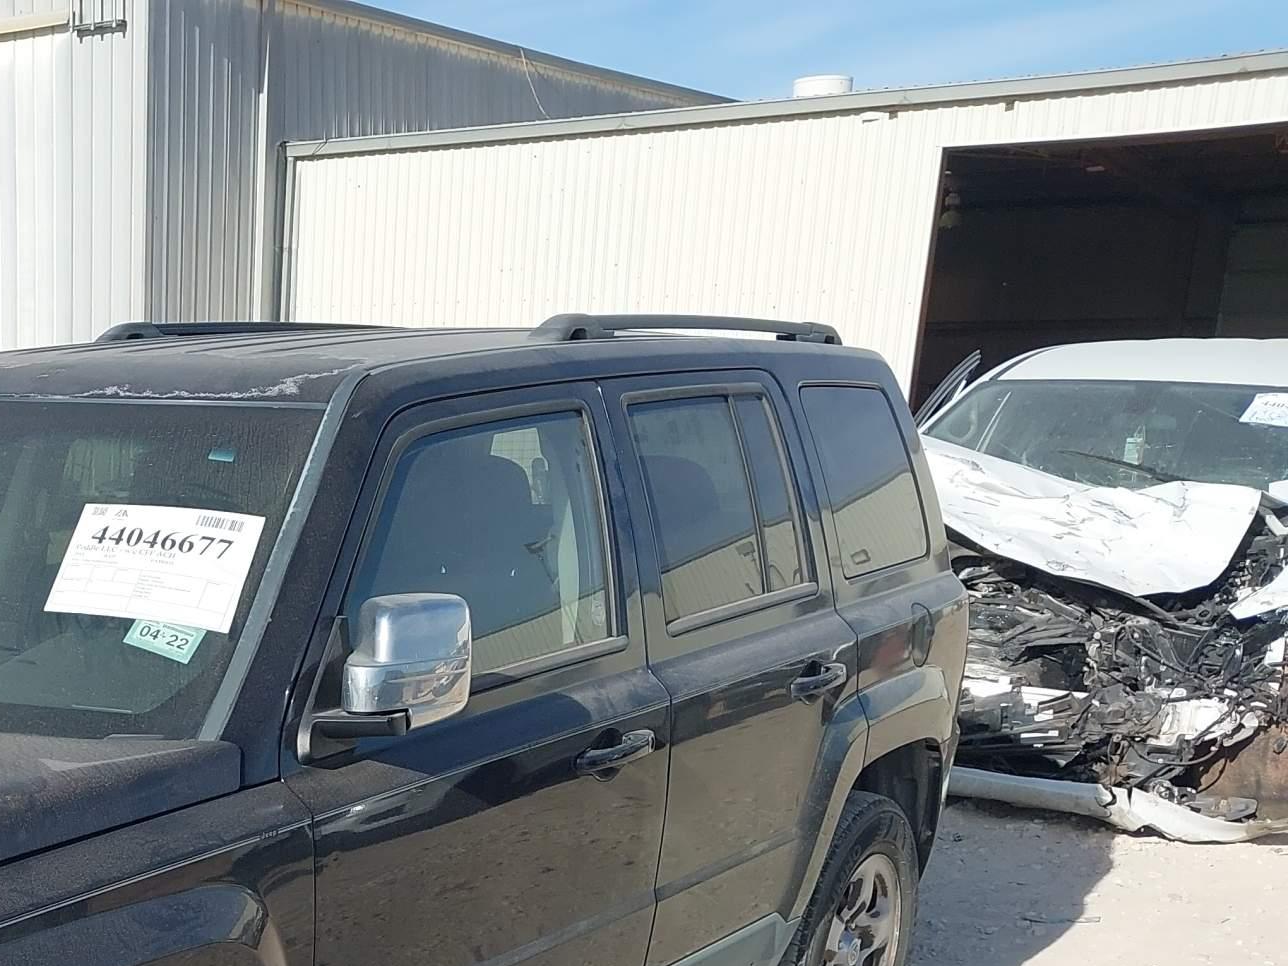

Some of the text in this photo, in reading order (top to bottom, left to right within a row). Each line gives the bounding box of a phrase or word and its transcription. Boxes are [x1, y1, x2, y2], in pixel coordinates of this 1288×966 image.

[91, 525, 234, 559] 44046677
[139, 624, 161, 641] 04
[165, 634, 190, 651] 22
